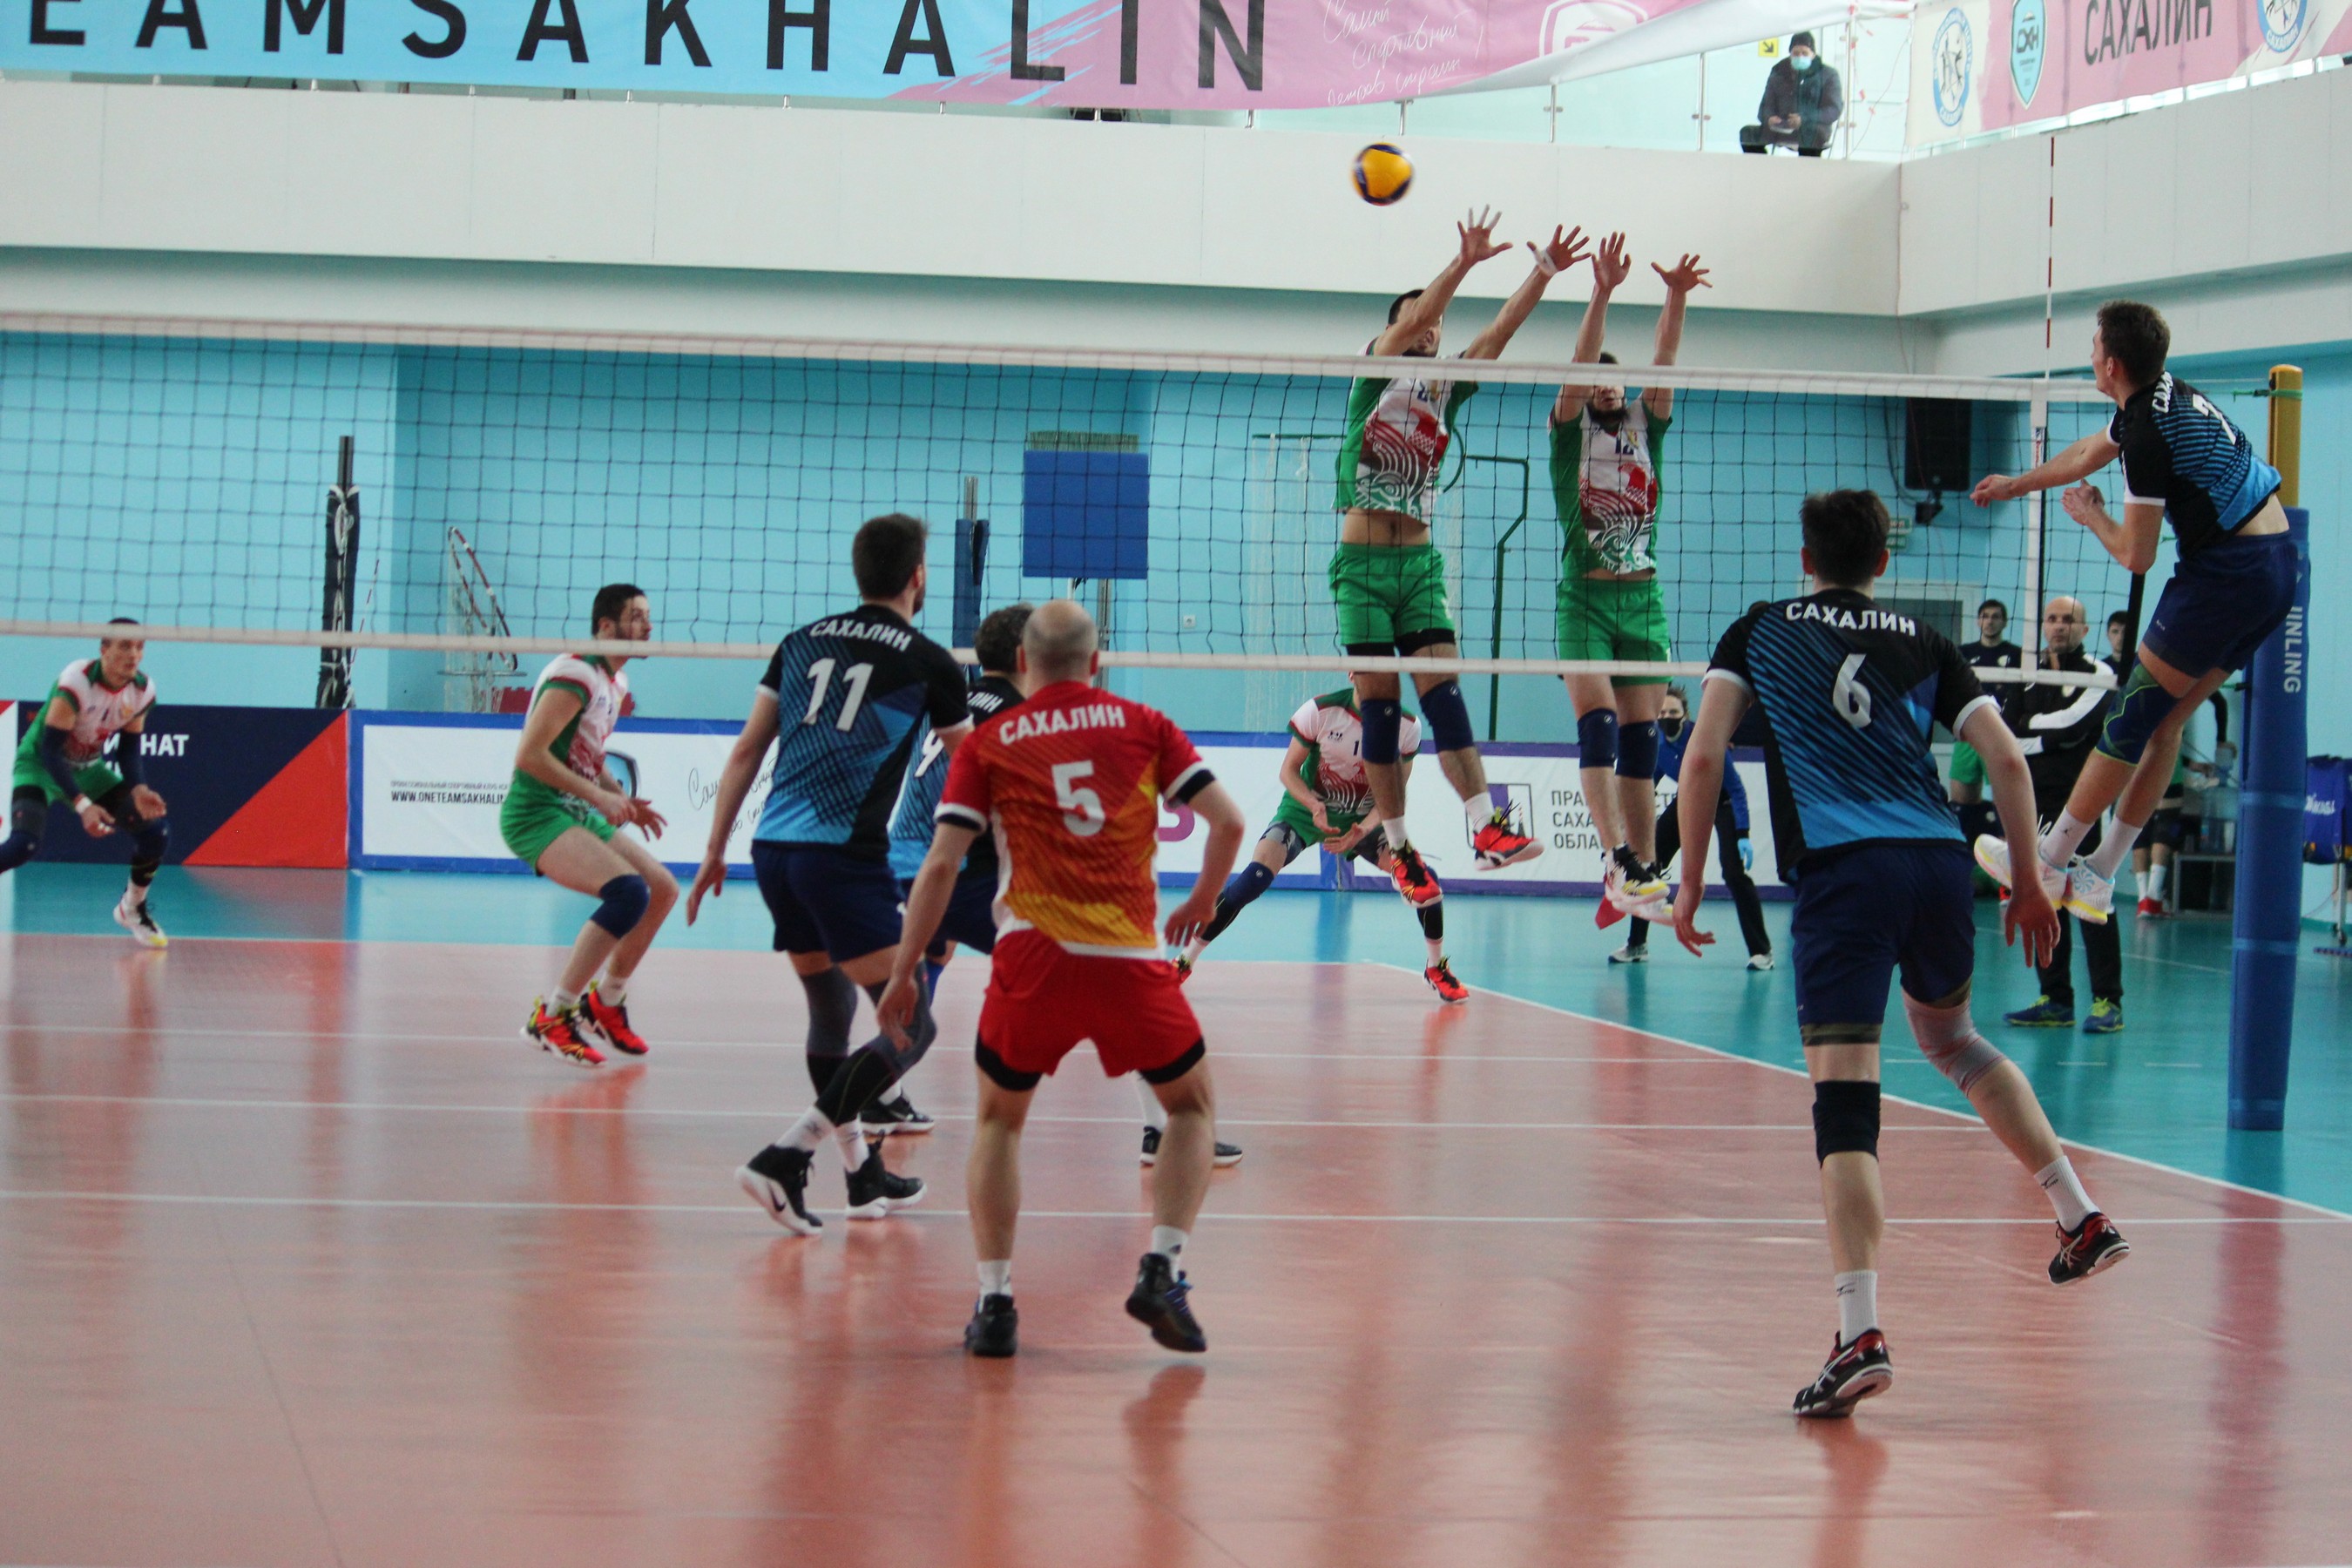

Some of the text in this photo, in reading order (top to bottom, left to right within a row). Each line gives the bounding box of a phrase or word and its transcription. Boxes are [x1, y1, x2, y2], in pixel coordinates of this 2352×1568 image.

[2085, 0, 2213, 65] САХАЛИН
[2193, 394, 2236, 445] 7
[809, 619, 912, 652] САХАЛИН
[1786, 602, 1916, 637] САХАЛИН
[802, 658, 874, 733] 11
[1833, 653, 1872, 727] 6
[999, 704, 1126, 746] САХАЛИН
[1051, 760, 1105, 836] 5
